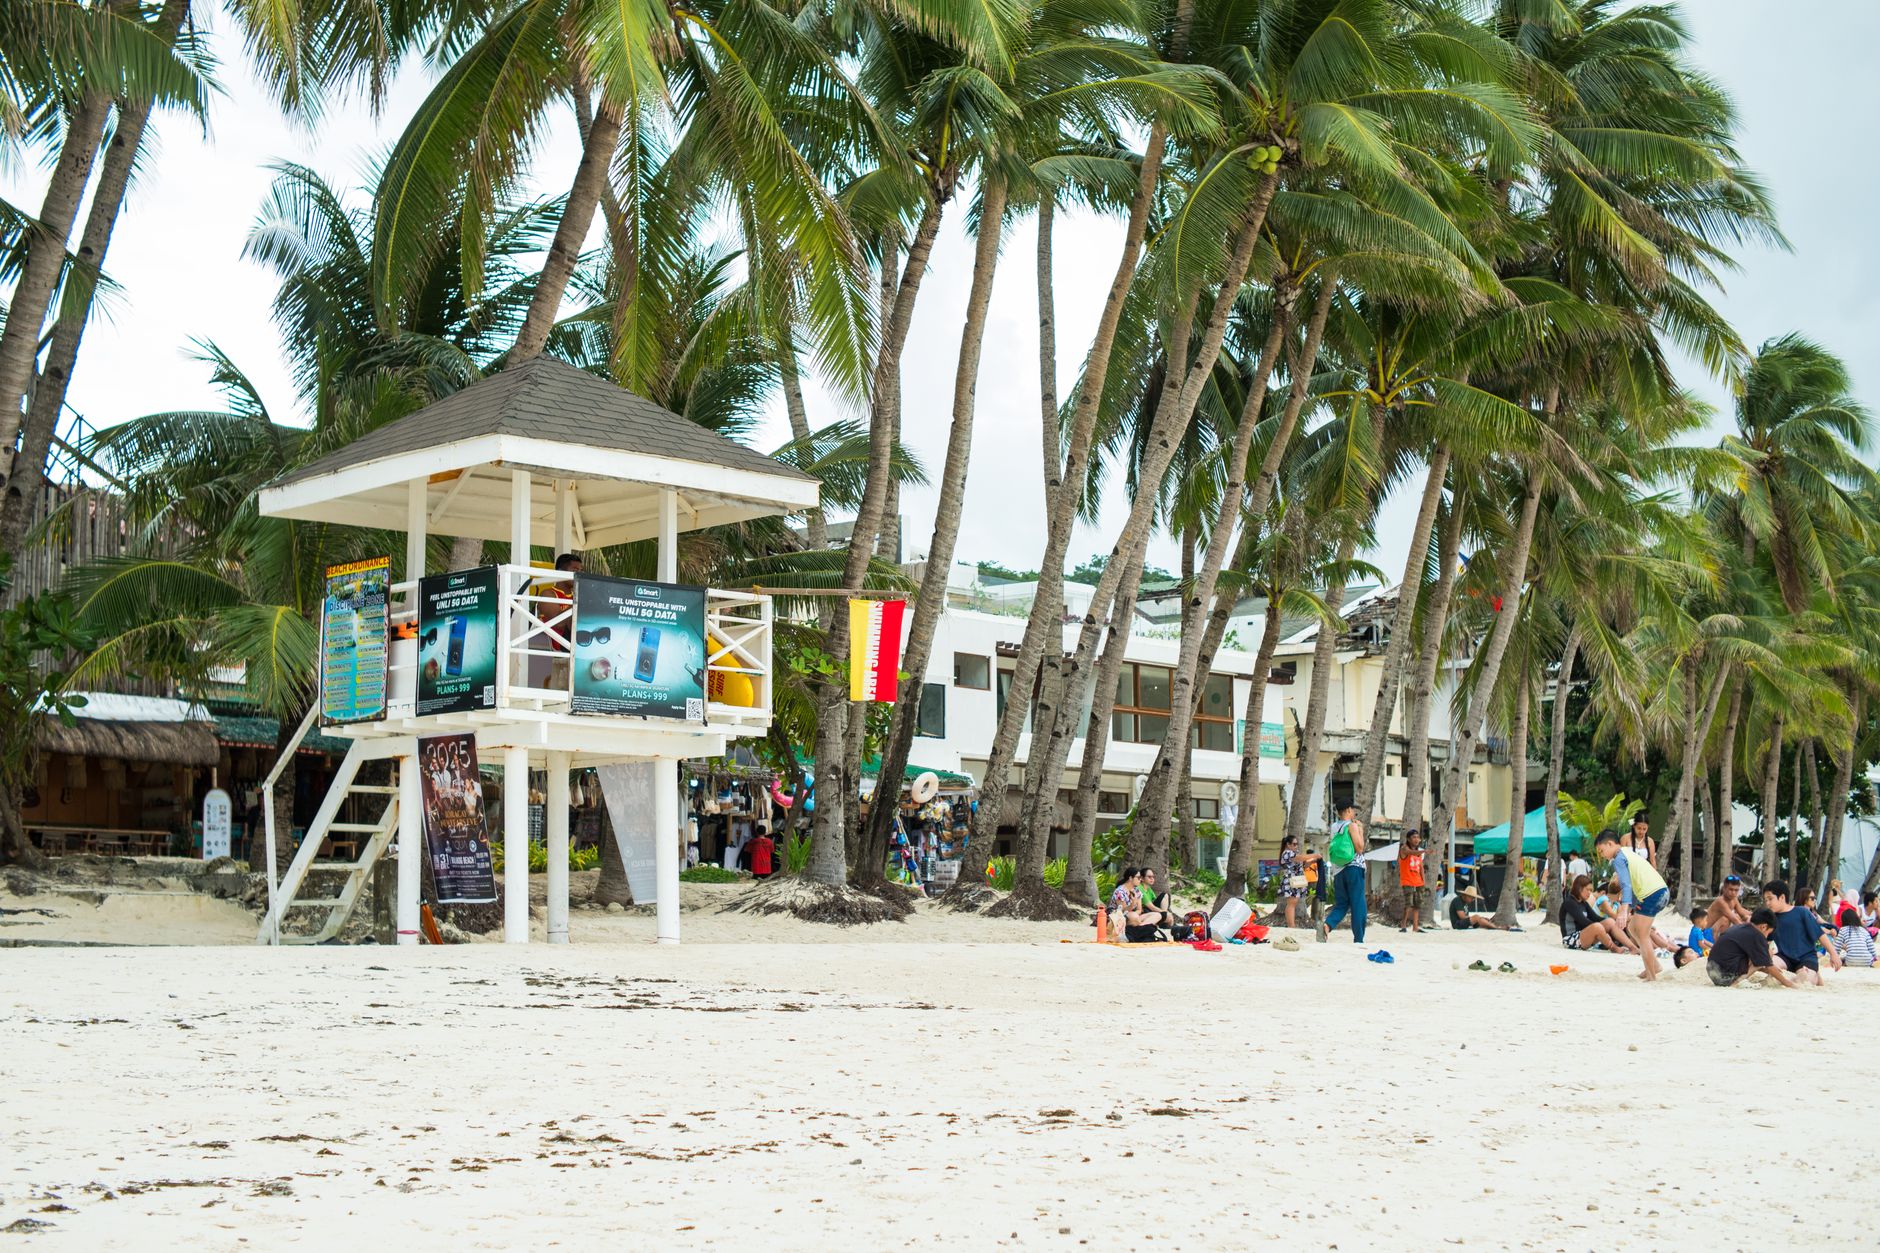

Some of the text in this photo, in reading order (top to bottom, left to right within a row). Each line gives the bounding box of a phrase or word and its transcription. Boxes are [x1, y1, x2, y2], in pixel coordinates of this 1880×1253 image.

[326, 564, 348, 576] BEACH
[349, 556, 390, 571] ORDINANCES
[430, 586, 487, 601] FEEL UNSTOPPABLE WITH
[643, 588, 659, 597] Smart
[436, 599, 451, 610] UNLI
[451, 598, 461, 607] 5G
[461, 595, 479, 606] DATA
[625, 599, 670, 610] UNSTOPPABLE
[619, 605, 677, 620] UNLI 5G DATA
[862, 600, 885, 701] SWIMMING AREA
[436, 683, 471, 695] PLANS+ 999
[715, 671, 725, 696] SURF
[622, 689, 668, 701] PLANS+ 999
[427, 741, 470, 770] 2025
[440, 853, 449, 864] 31
